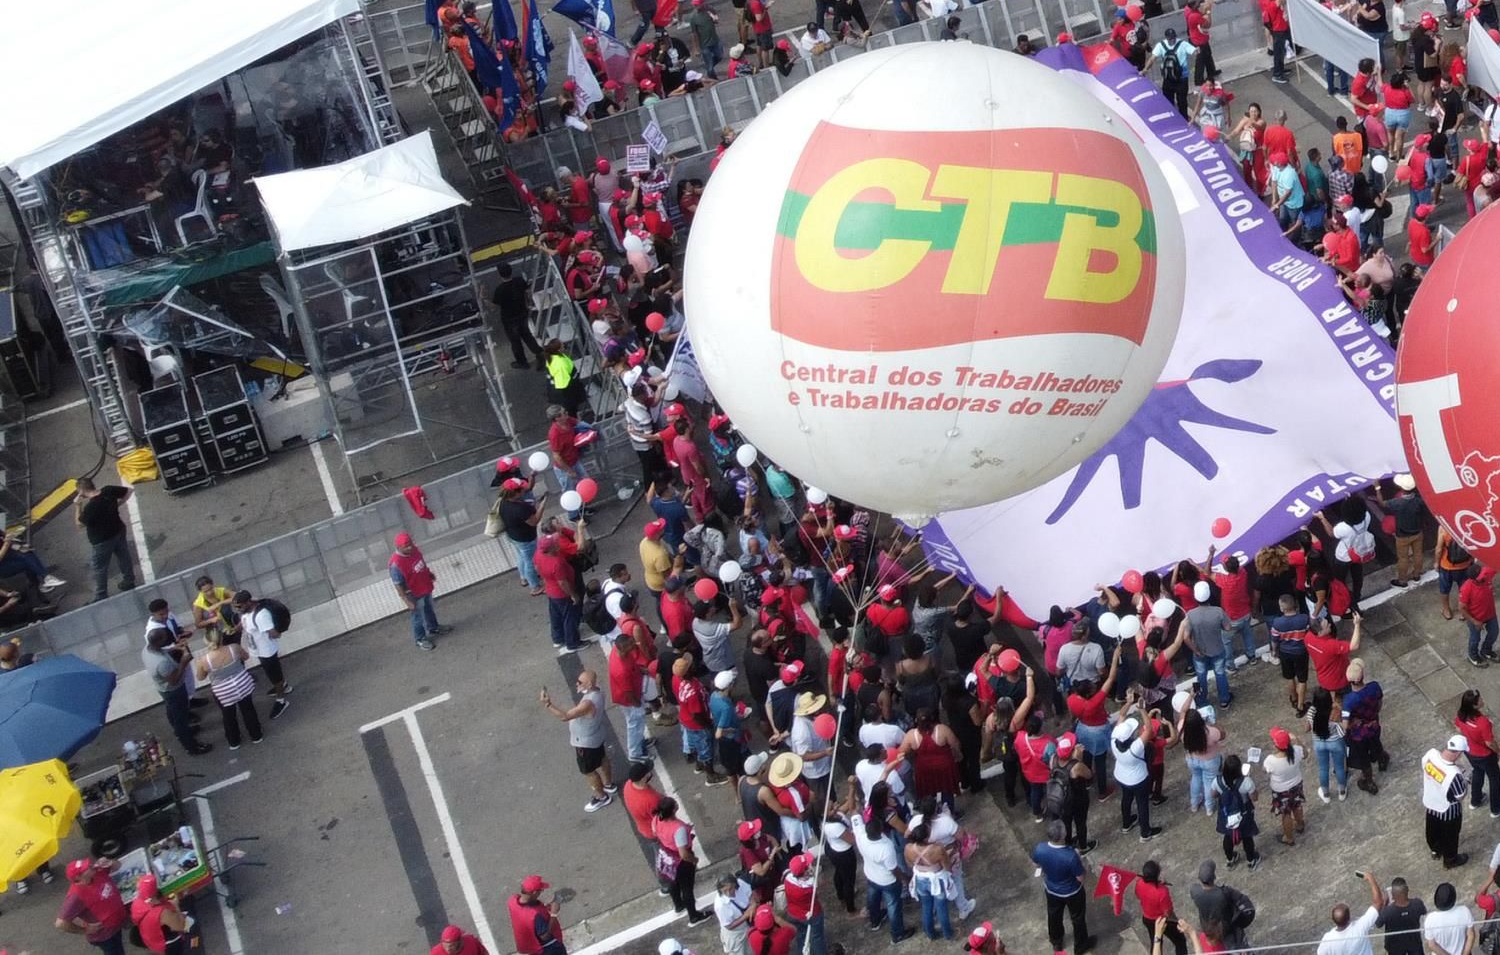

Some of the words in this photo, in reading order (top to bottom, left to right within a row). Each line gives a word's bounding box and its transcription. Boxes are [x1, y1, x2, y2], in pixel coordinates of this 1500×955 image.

[1182, 139, 1264, 234] POPULAR
[794, 156, 1144, 305] CTB
[1266, 254, 1323, 293] PODER
[780, 358, 876, 386] Central
[887, 362, 943, 388] dos
[953, 365, 1124, 397] Trabalhadores
[787, 391, 800, 406] e
[809, 387, 1001, 416] Trabalhadoras
[1007, 394, 1043, 417] do
[1046, 396, 1108, 418] Brasil
